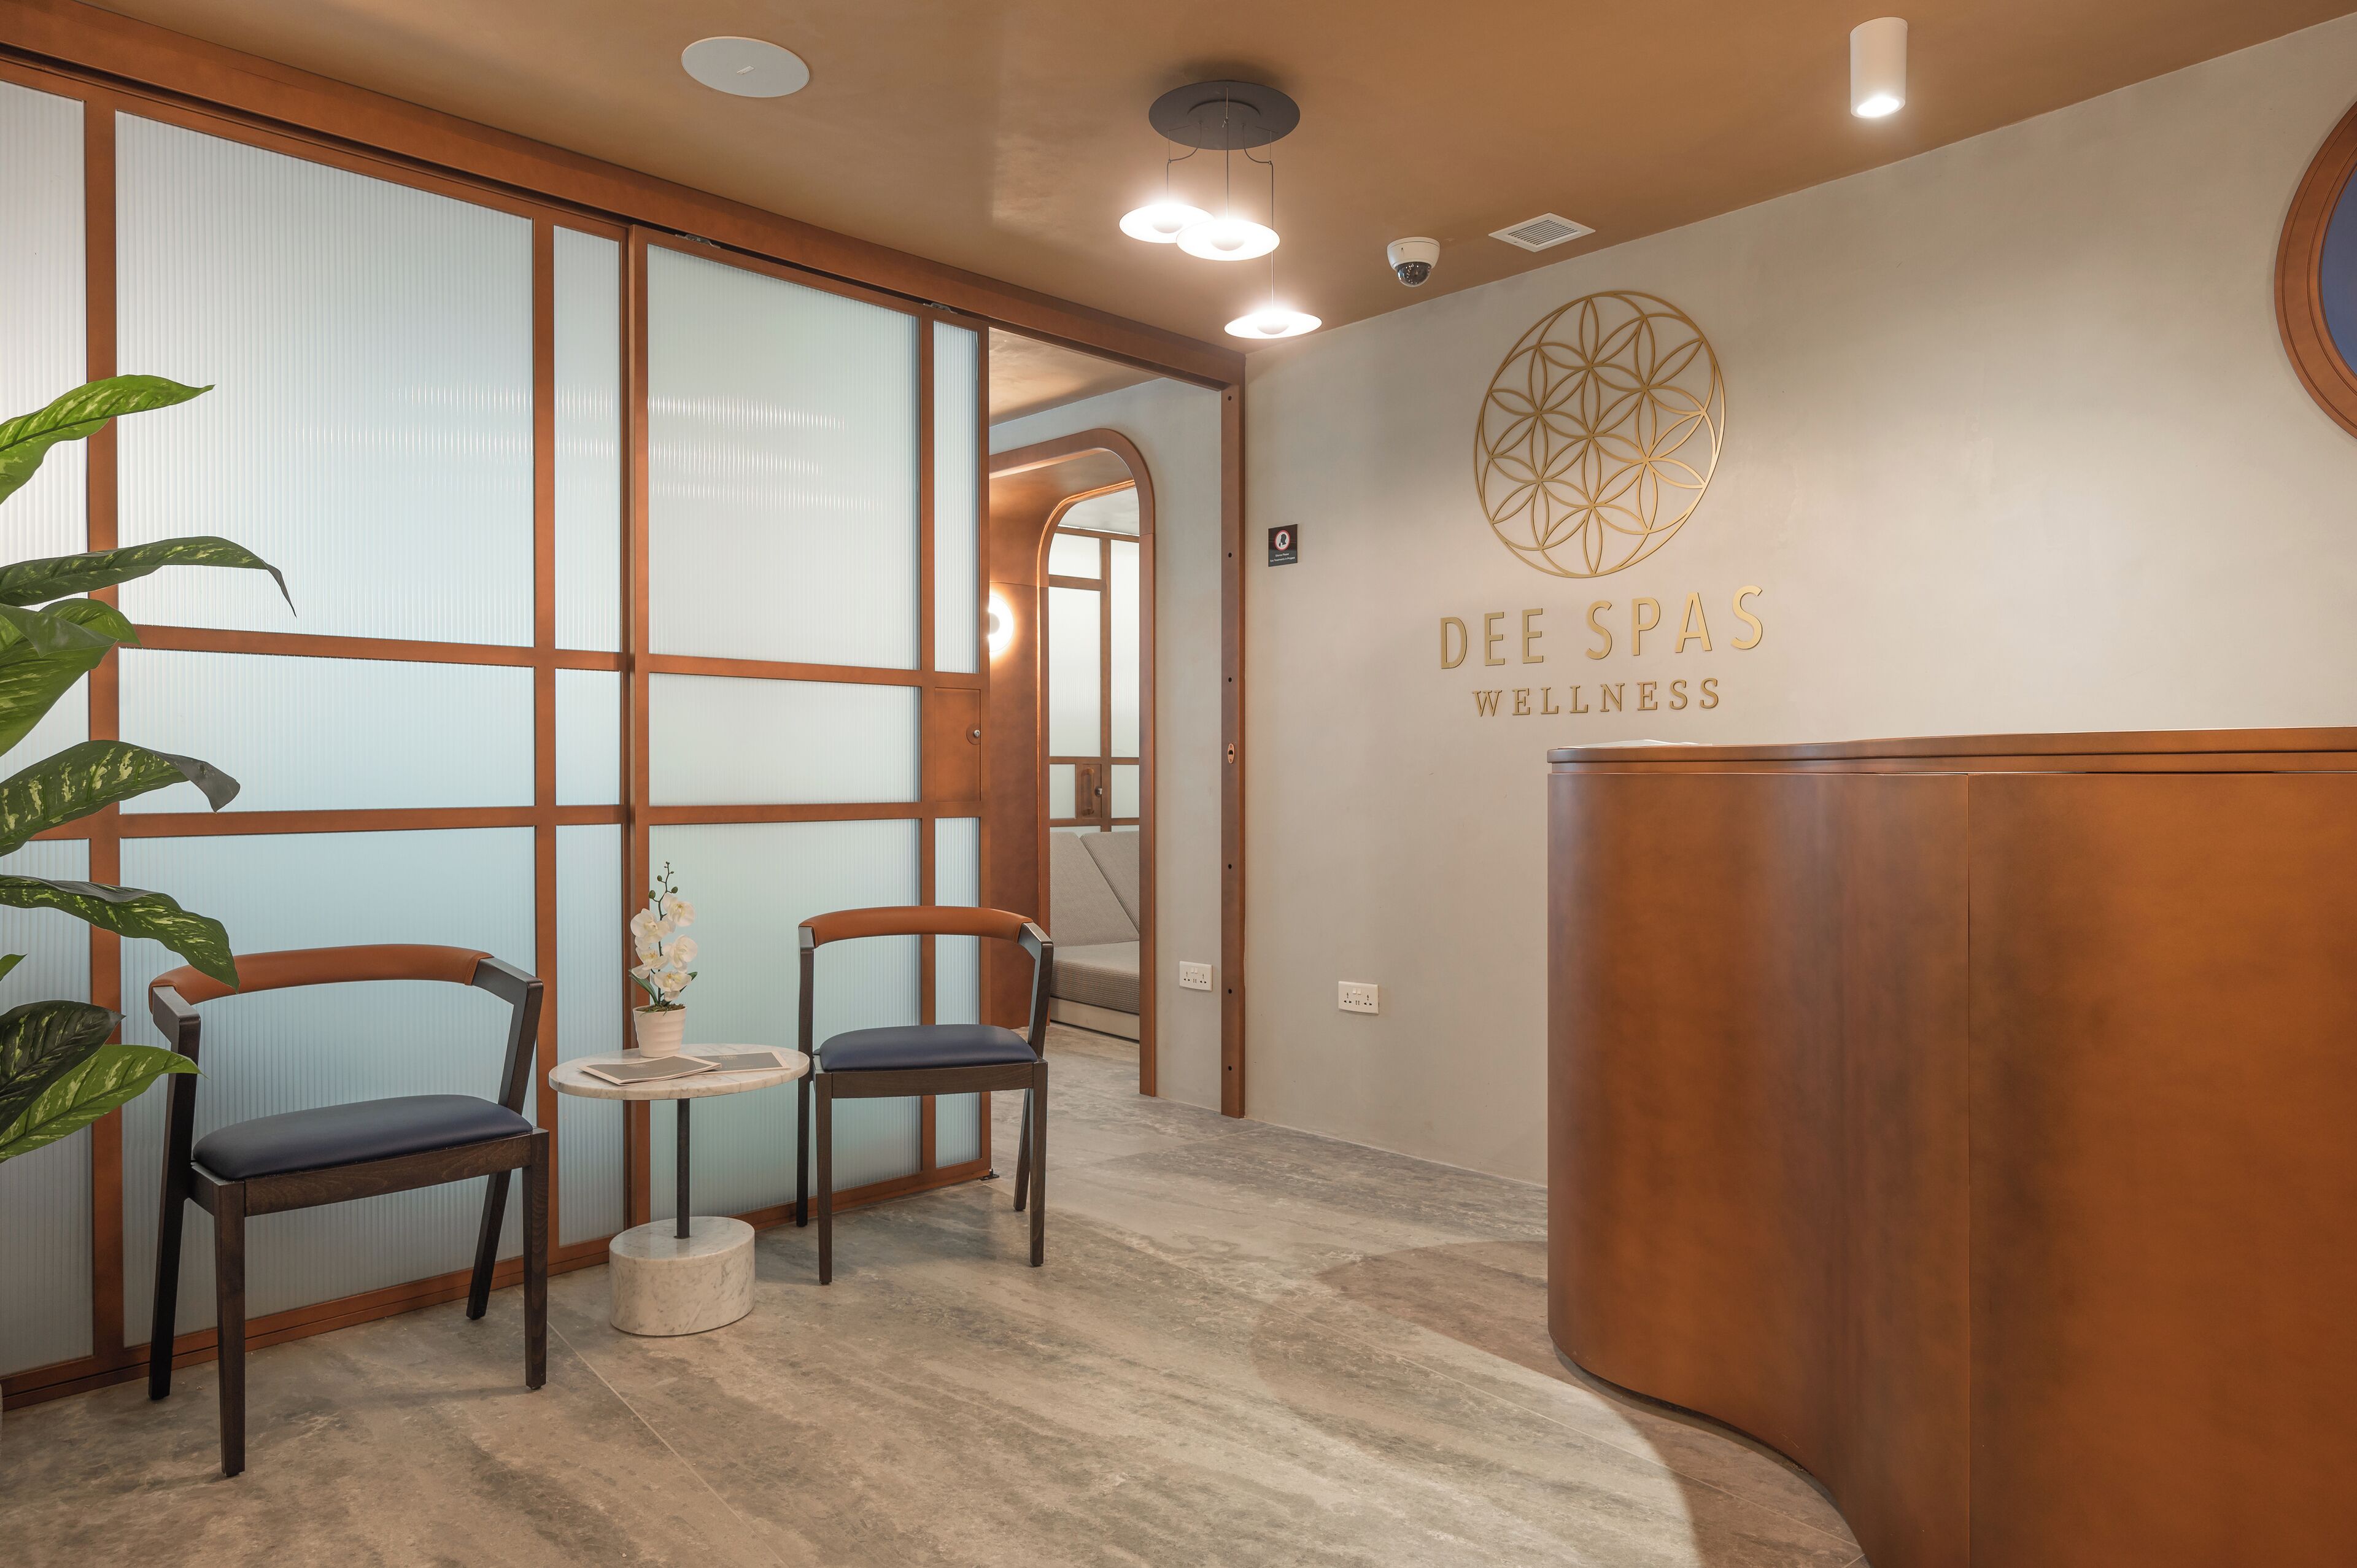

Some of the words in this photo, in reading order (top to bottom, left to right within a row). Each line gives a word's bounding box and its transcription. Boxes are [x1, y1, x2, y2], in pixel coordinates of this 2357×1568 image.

[1440, 608, 1544, 669] DEE
[1585, 585, 1763, 660] SPAS
[1472, 678, 1719, 717] WELLNESS
